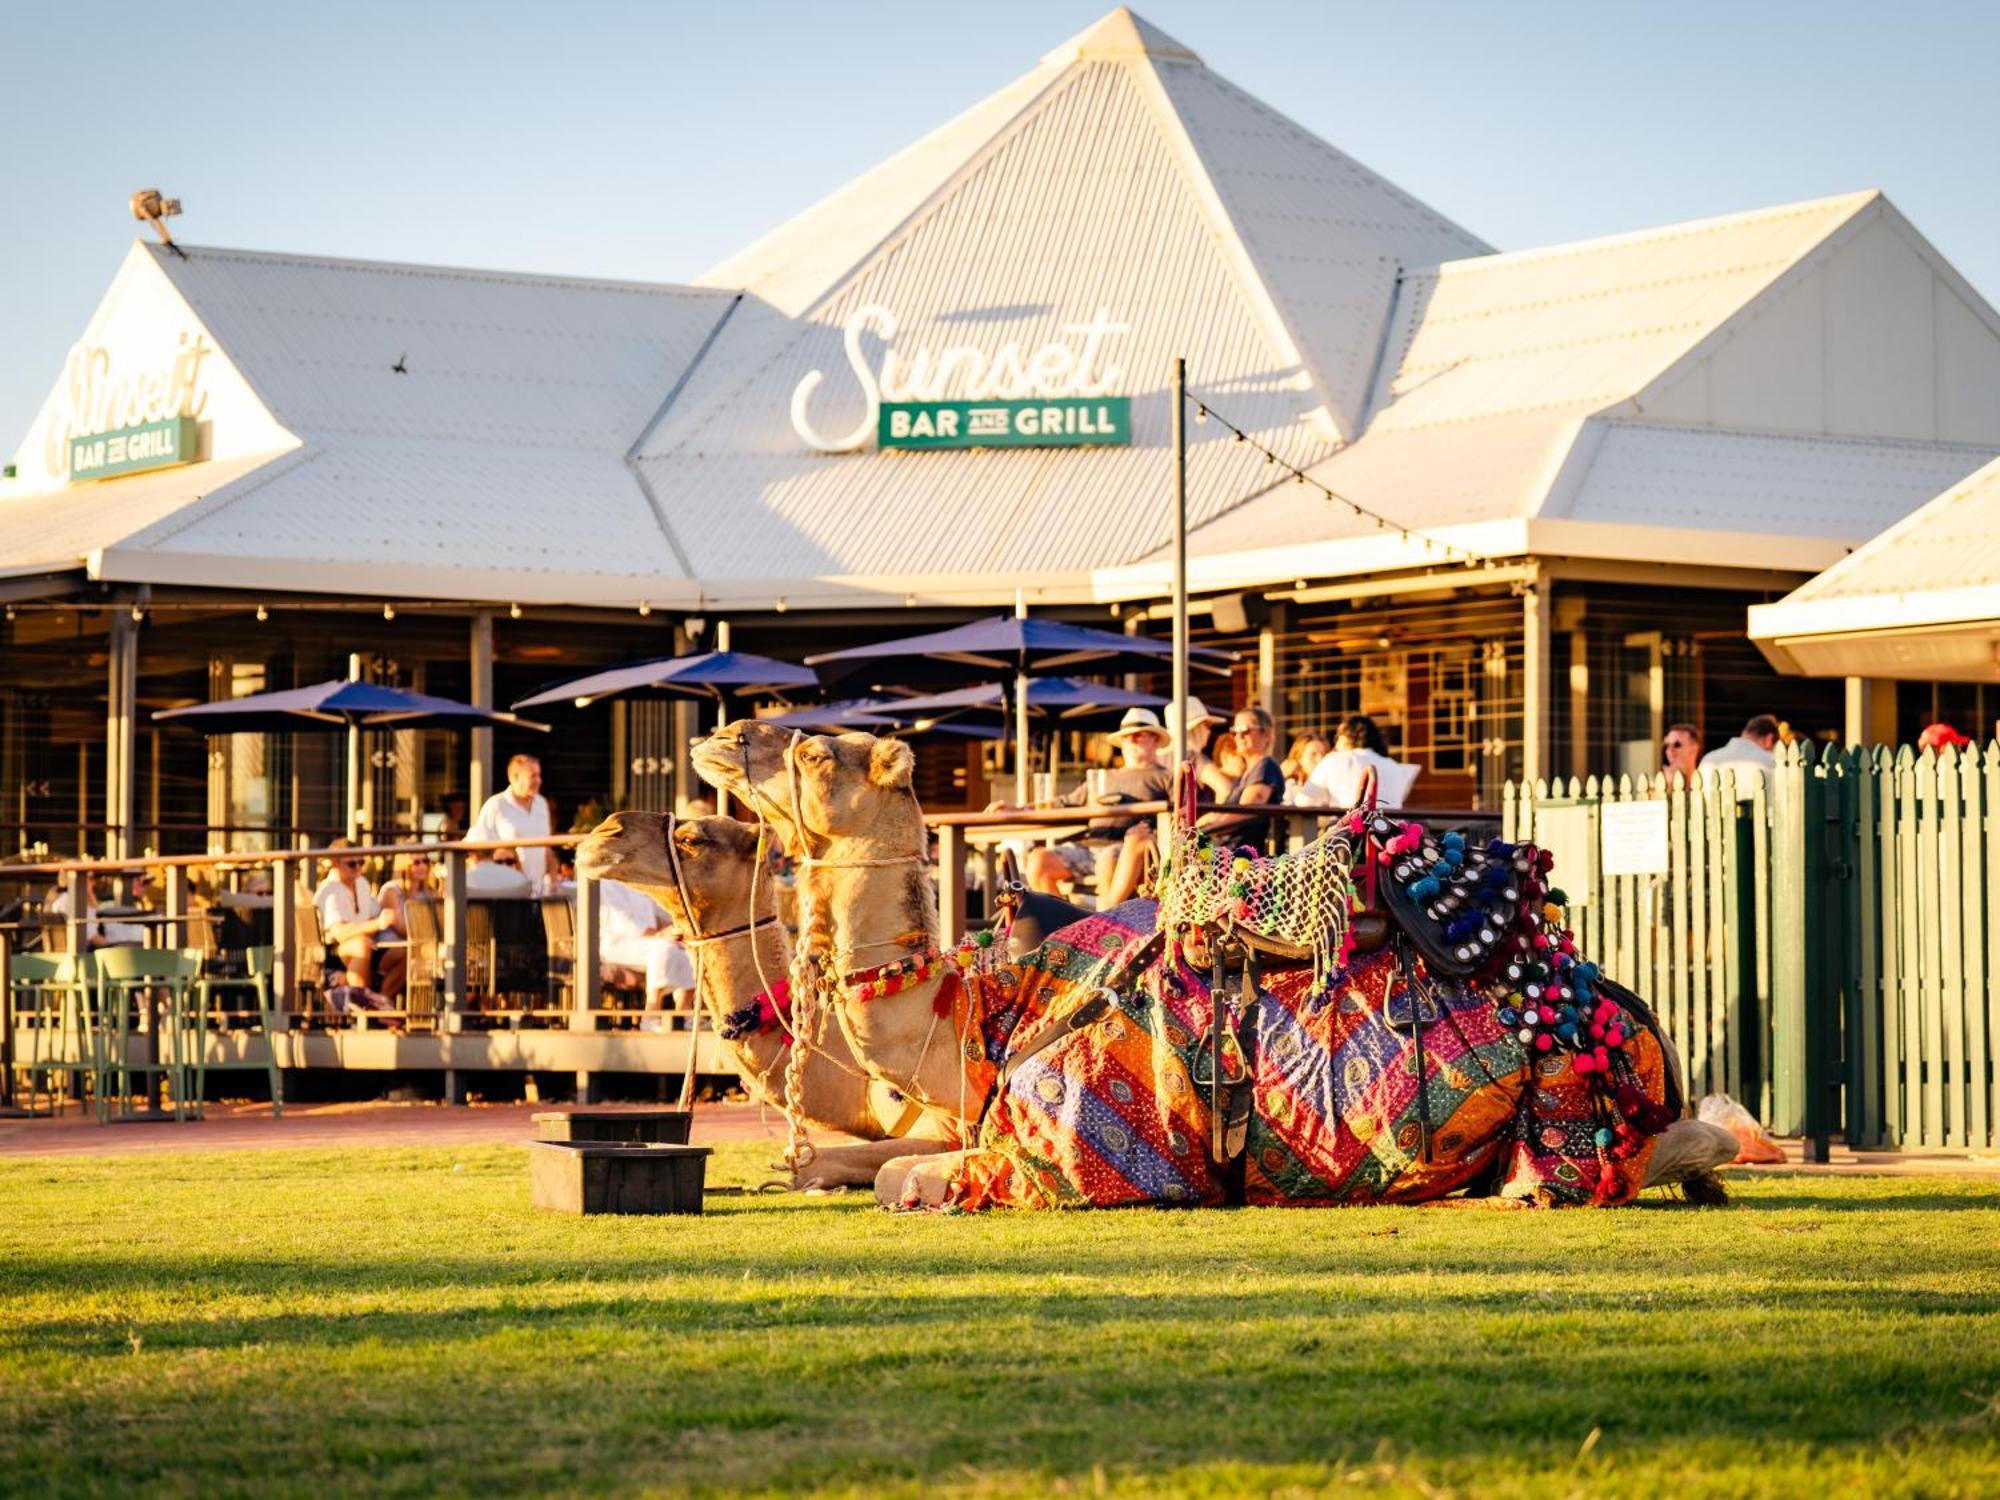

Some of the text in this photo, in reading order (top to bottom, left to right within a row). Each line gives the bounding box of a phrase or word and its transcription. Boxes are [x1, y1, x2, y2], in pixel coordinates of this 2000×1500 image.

[790, 303, 1131, 453] Sunset
[890, 406, 1117, 438] BAR AND GRILL
[74, 441, 106, 471] BAR
[128, 428, 174, 461] GRILL
